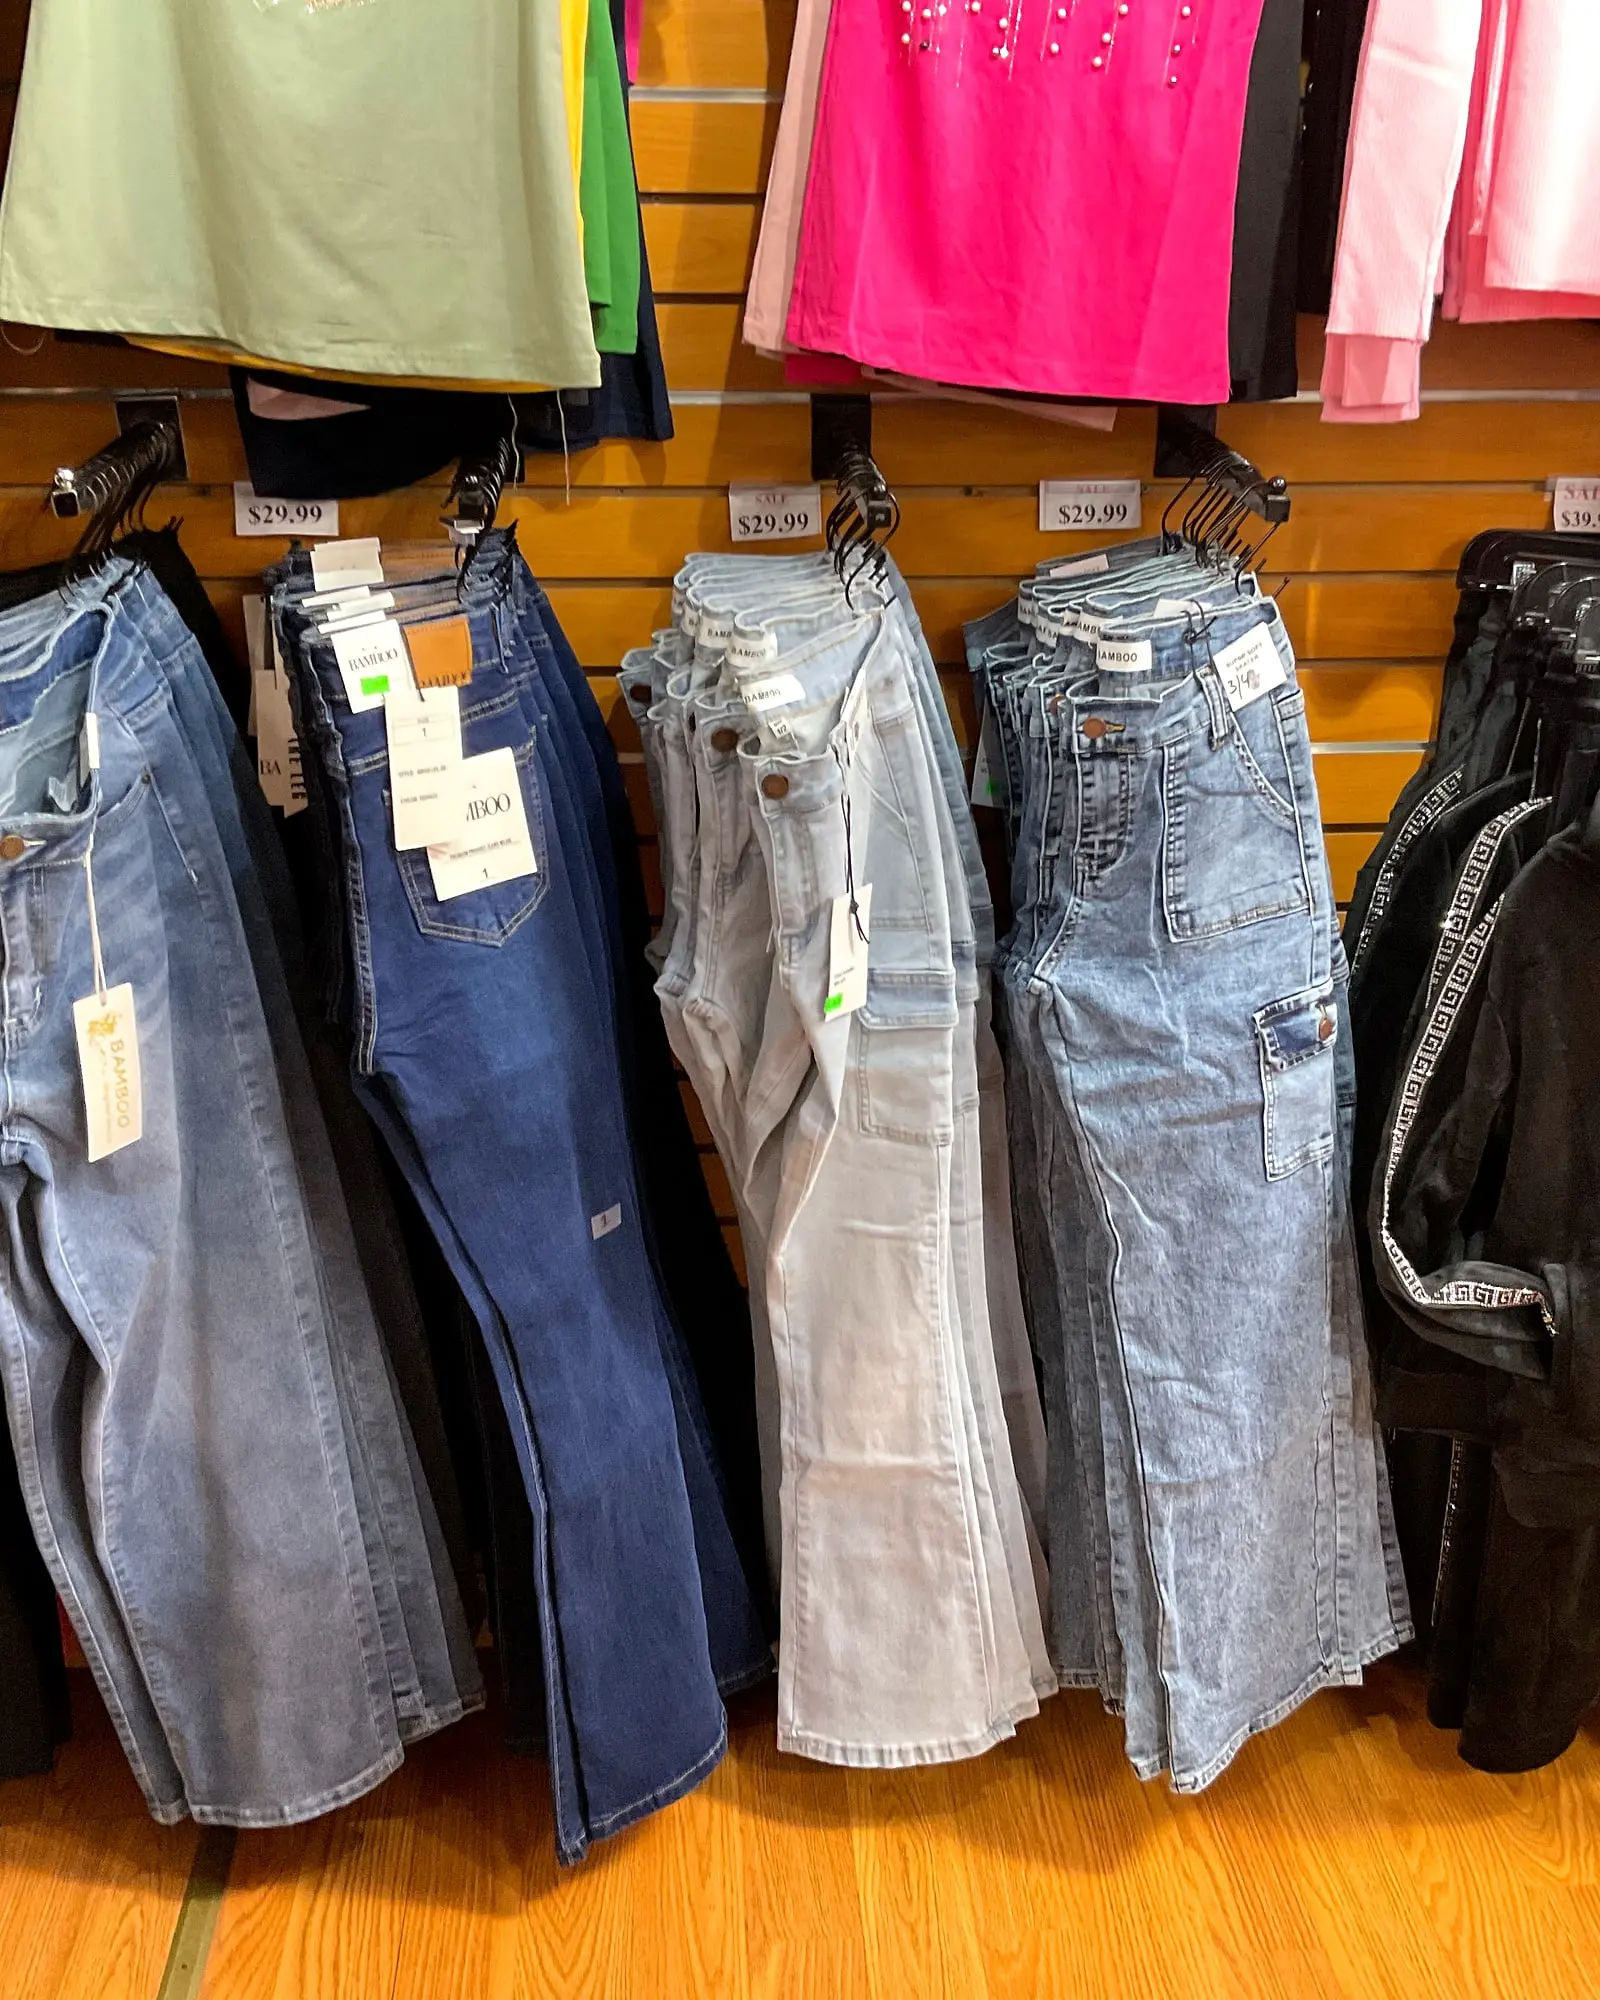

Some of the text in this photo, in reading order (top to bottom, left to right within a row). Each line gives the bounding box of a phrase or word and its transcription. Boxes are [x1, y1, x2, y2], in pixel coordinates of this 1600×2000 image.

[248, 504, 323, 526] $29.99
[738, 512, 809, 536] $29.99
[1058, 504, 1128, 525] $29.99
[1561, 511, 1600, 528] $39.
[348, 647, 399, 672] BAMBOO
[111, 1039, 131, 1129] BAMBOO
